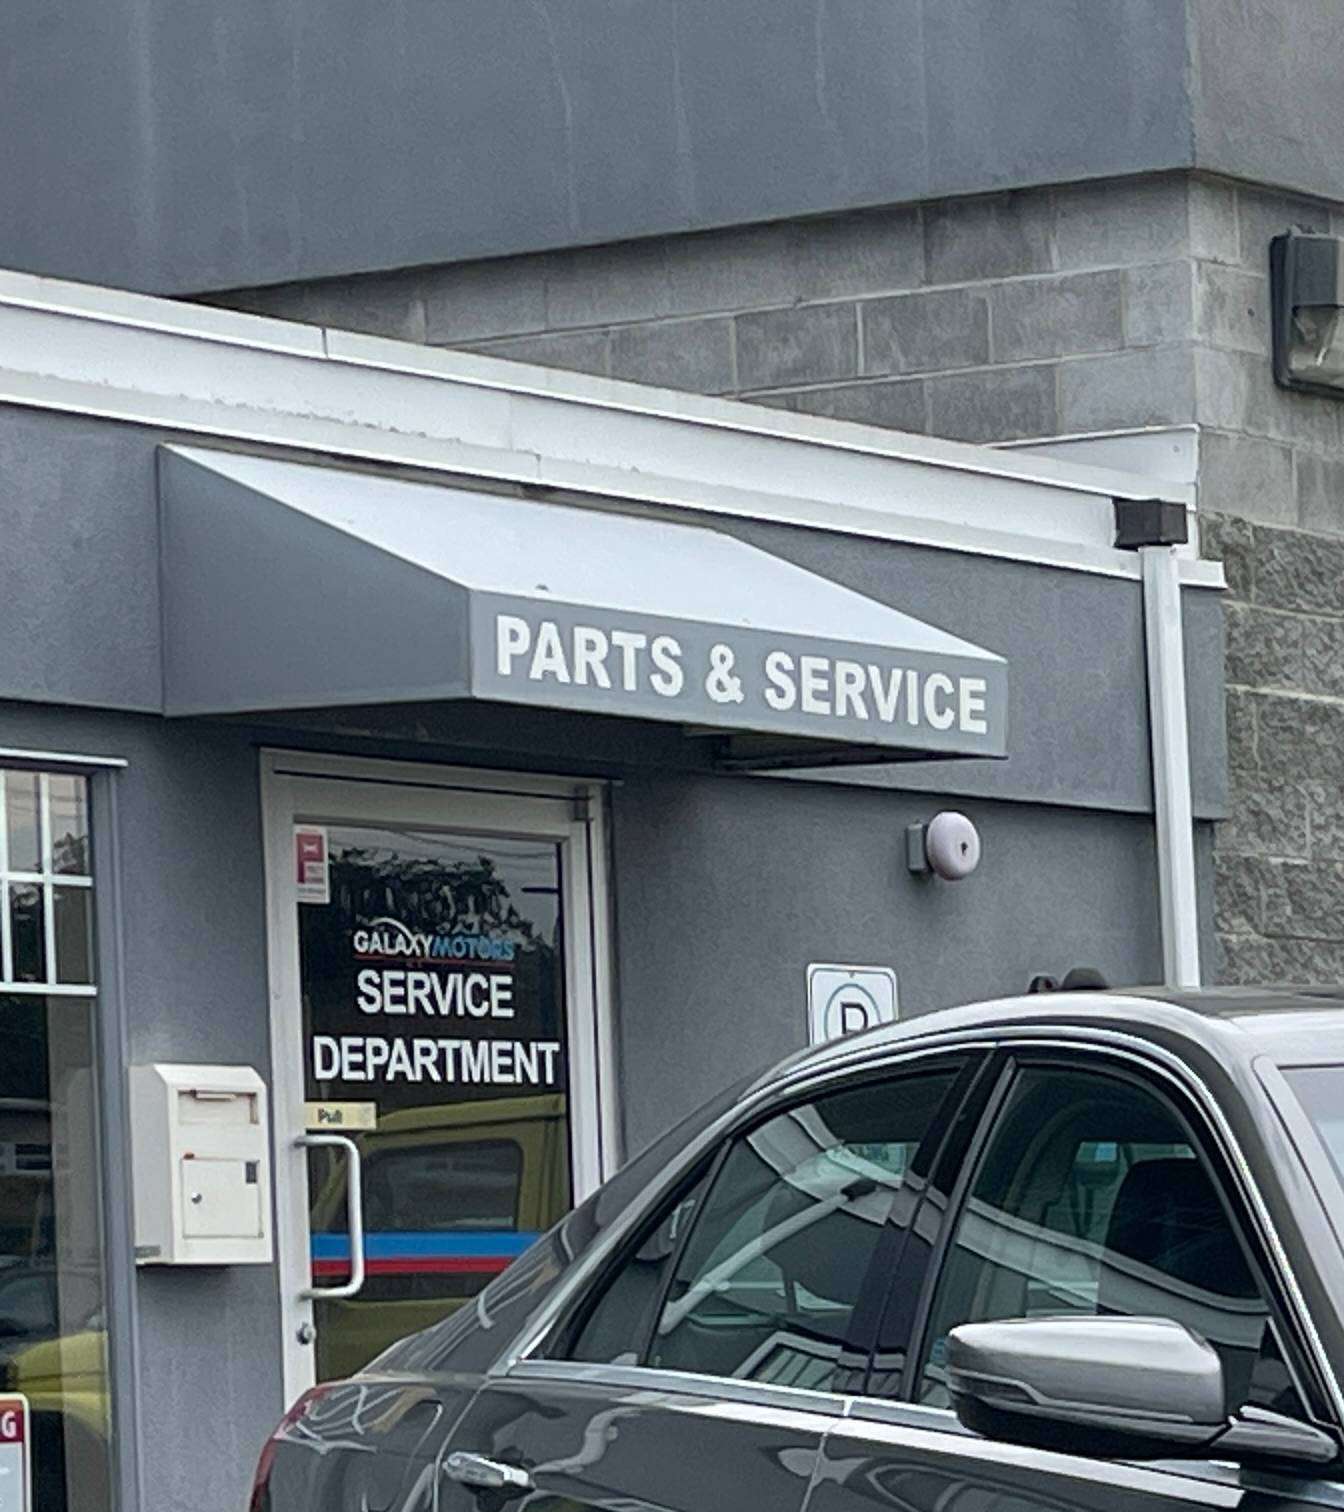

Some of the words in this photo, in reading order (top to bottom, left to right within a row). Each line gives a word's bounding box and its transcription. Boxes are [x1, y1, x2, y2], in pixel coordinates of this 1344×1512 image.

[496, 614, 685, 698] PARTS
[705, 643, 745, 705] &
[764, 650, 988, 735] SERVICE
[356, 968, 515, 1018] SERVICE
[312, 1034, 560, 1085] DEPARTMENT
